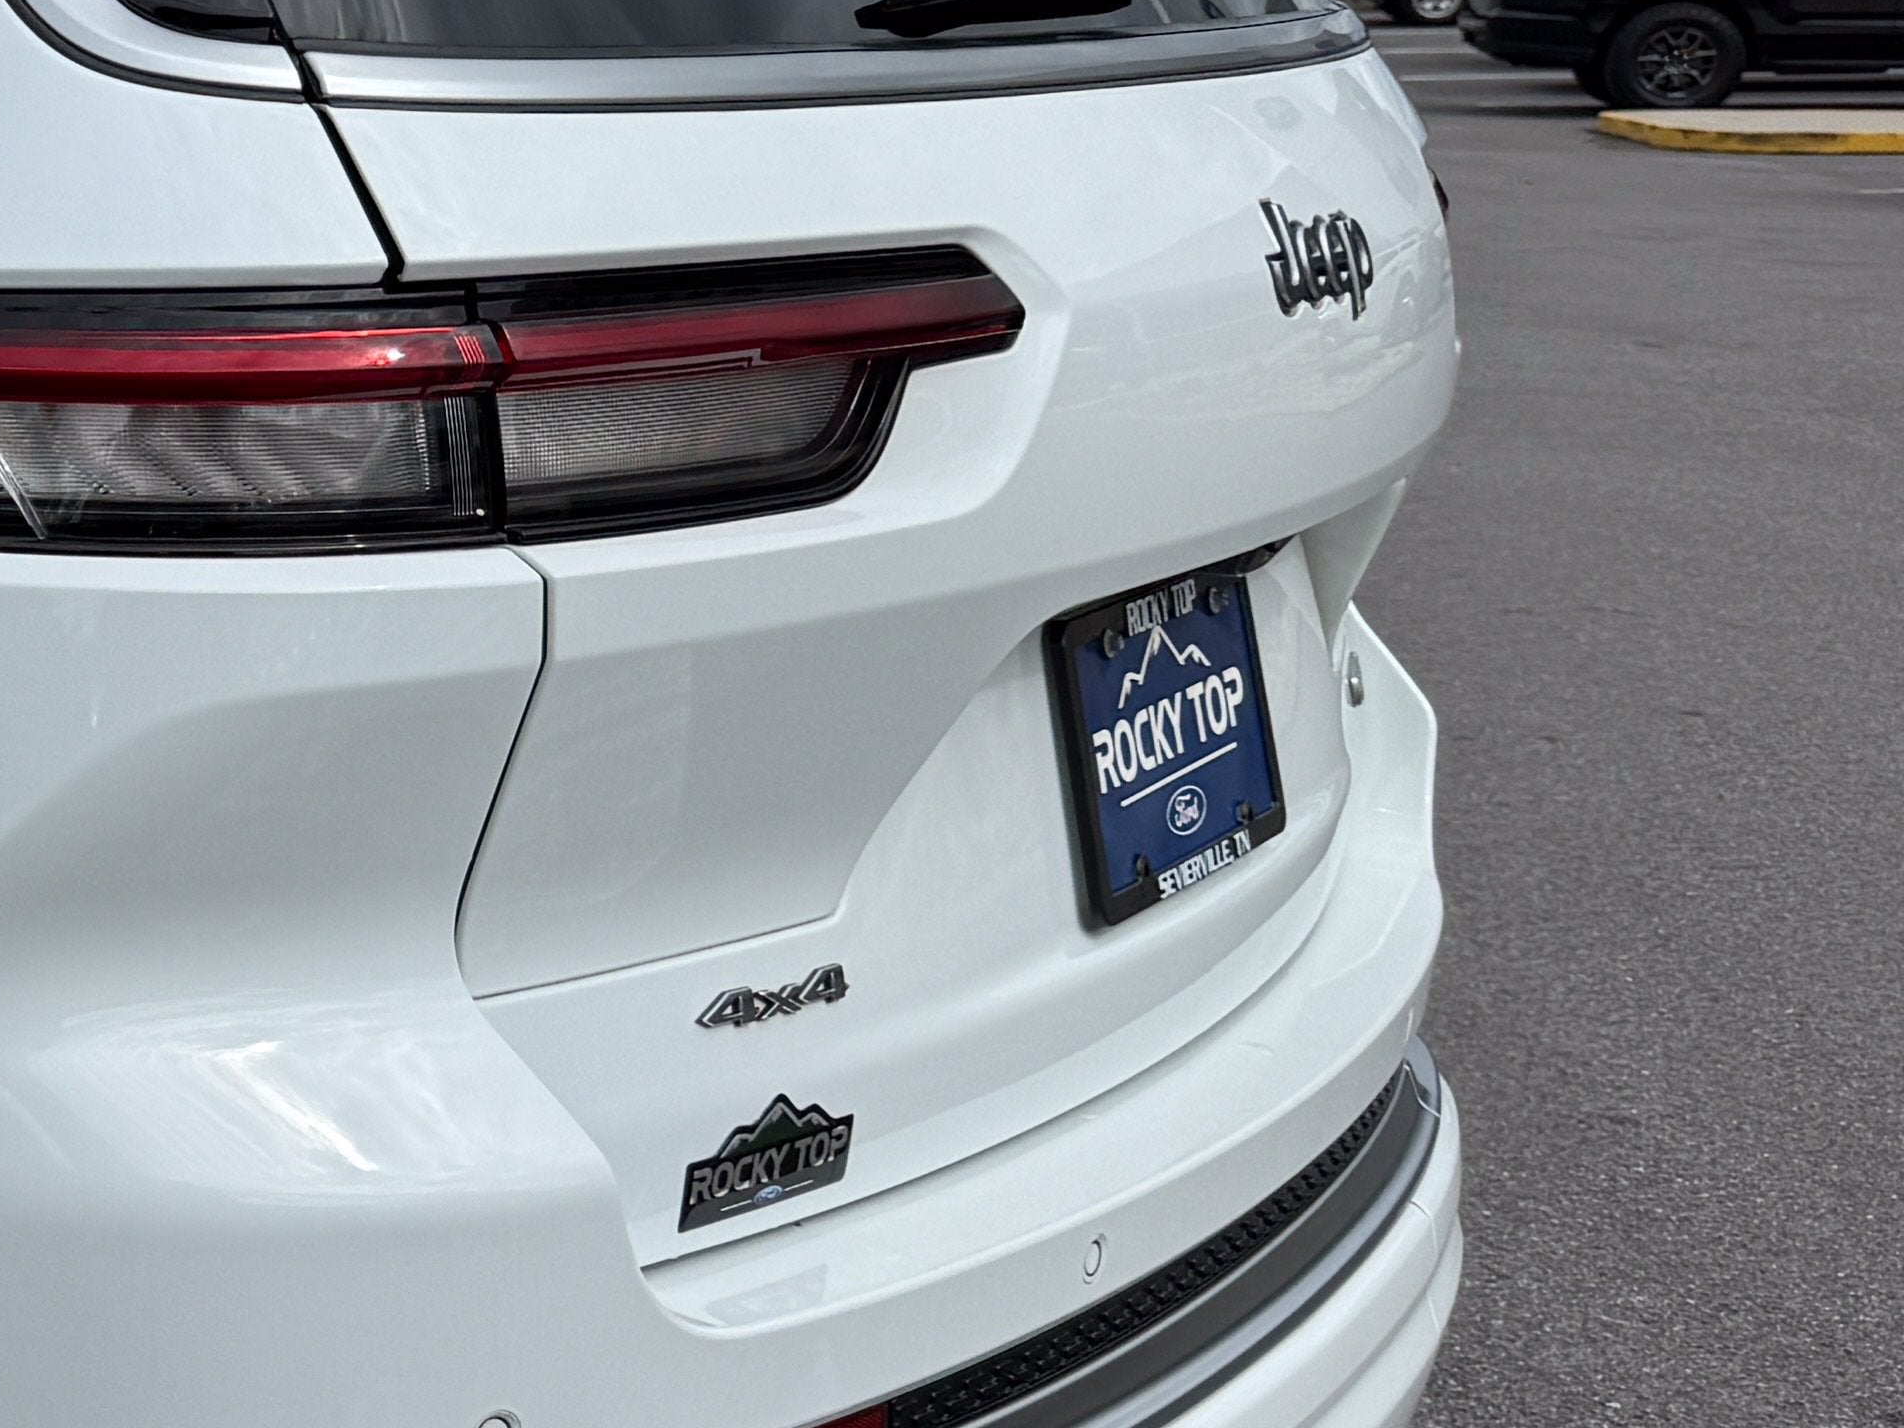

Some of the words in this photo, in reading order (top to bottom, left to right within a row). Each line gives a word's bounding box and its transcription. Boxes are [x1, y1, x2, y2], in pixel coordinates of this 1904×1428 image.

[1126, 588, 1169, 637] ROCKY
[1171, 579, 1196, 618] TOP
[1093, 692, 1184, 794] ROCKY
[1186, 666, 1244, 742] TOP
[1233, 829, 1251, 857] TN
[689, 1144, 790, 1205] ROCKY
[794, 1125, 849, 1170] TOP
